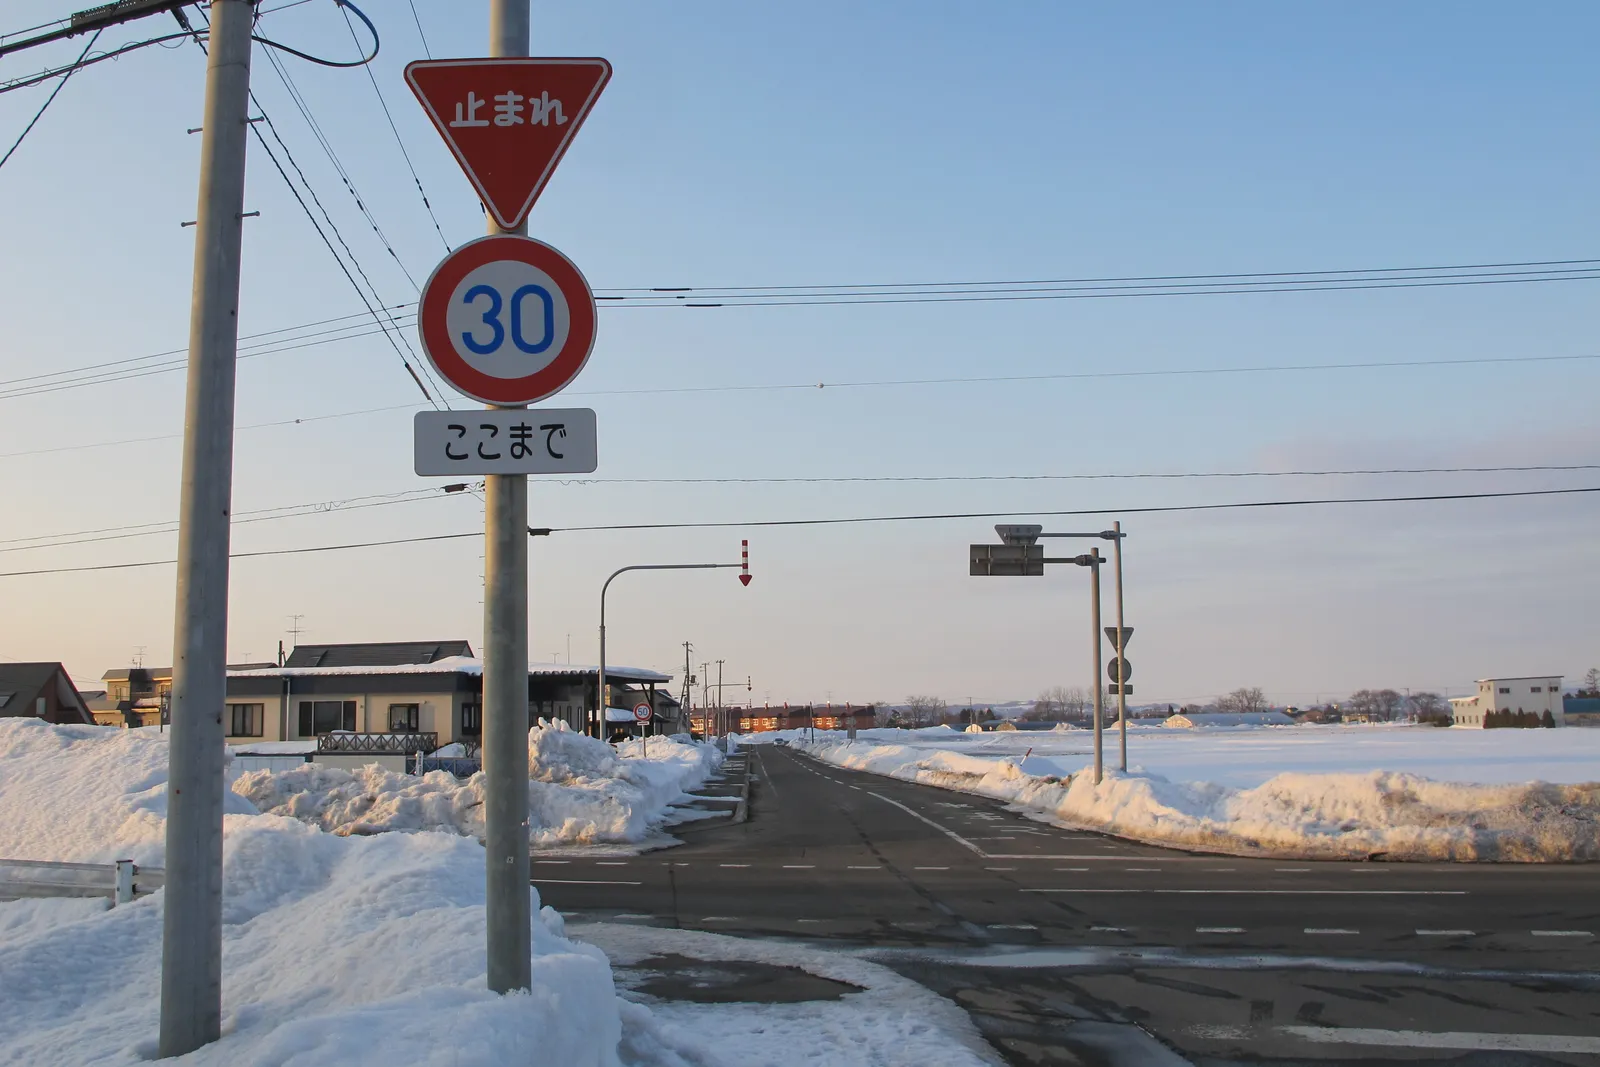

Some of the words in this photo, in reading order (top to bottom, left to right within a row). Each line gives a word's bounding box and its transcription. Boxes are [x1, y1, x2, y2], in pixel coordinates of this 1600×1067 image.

[449, 90, 568, 127] 止まれ
[462, 284, 554, 354] 30
[446, 421, 566, 461] ここまで
[637, 707, 649, 716] 50
